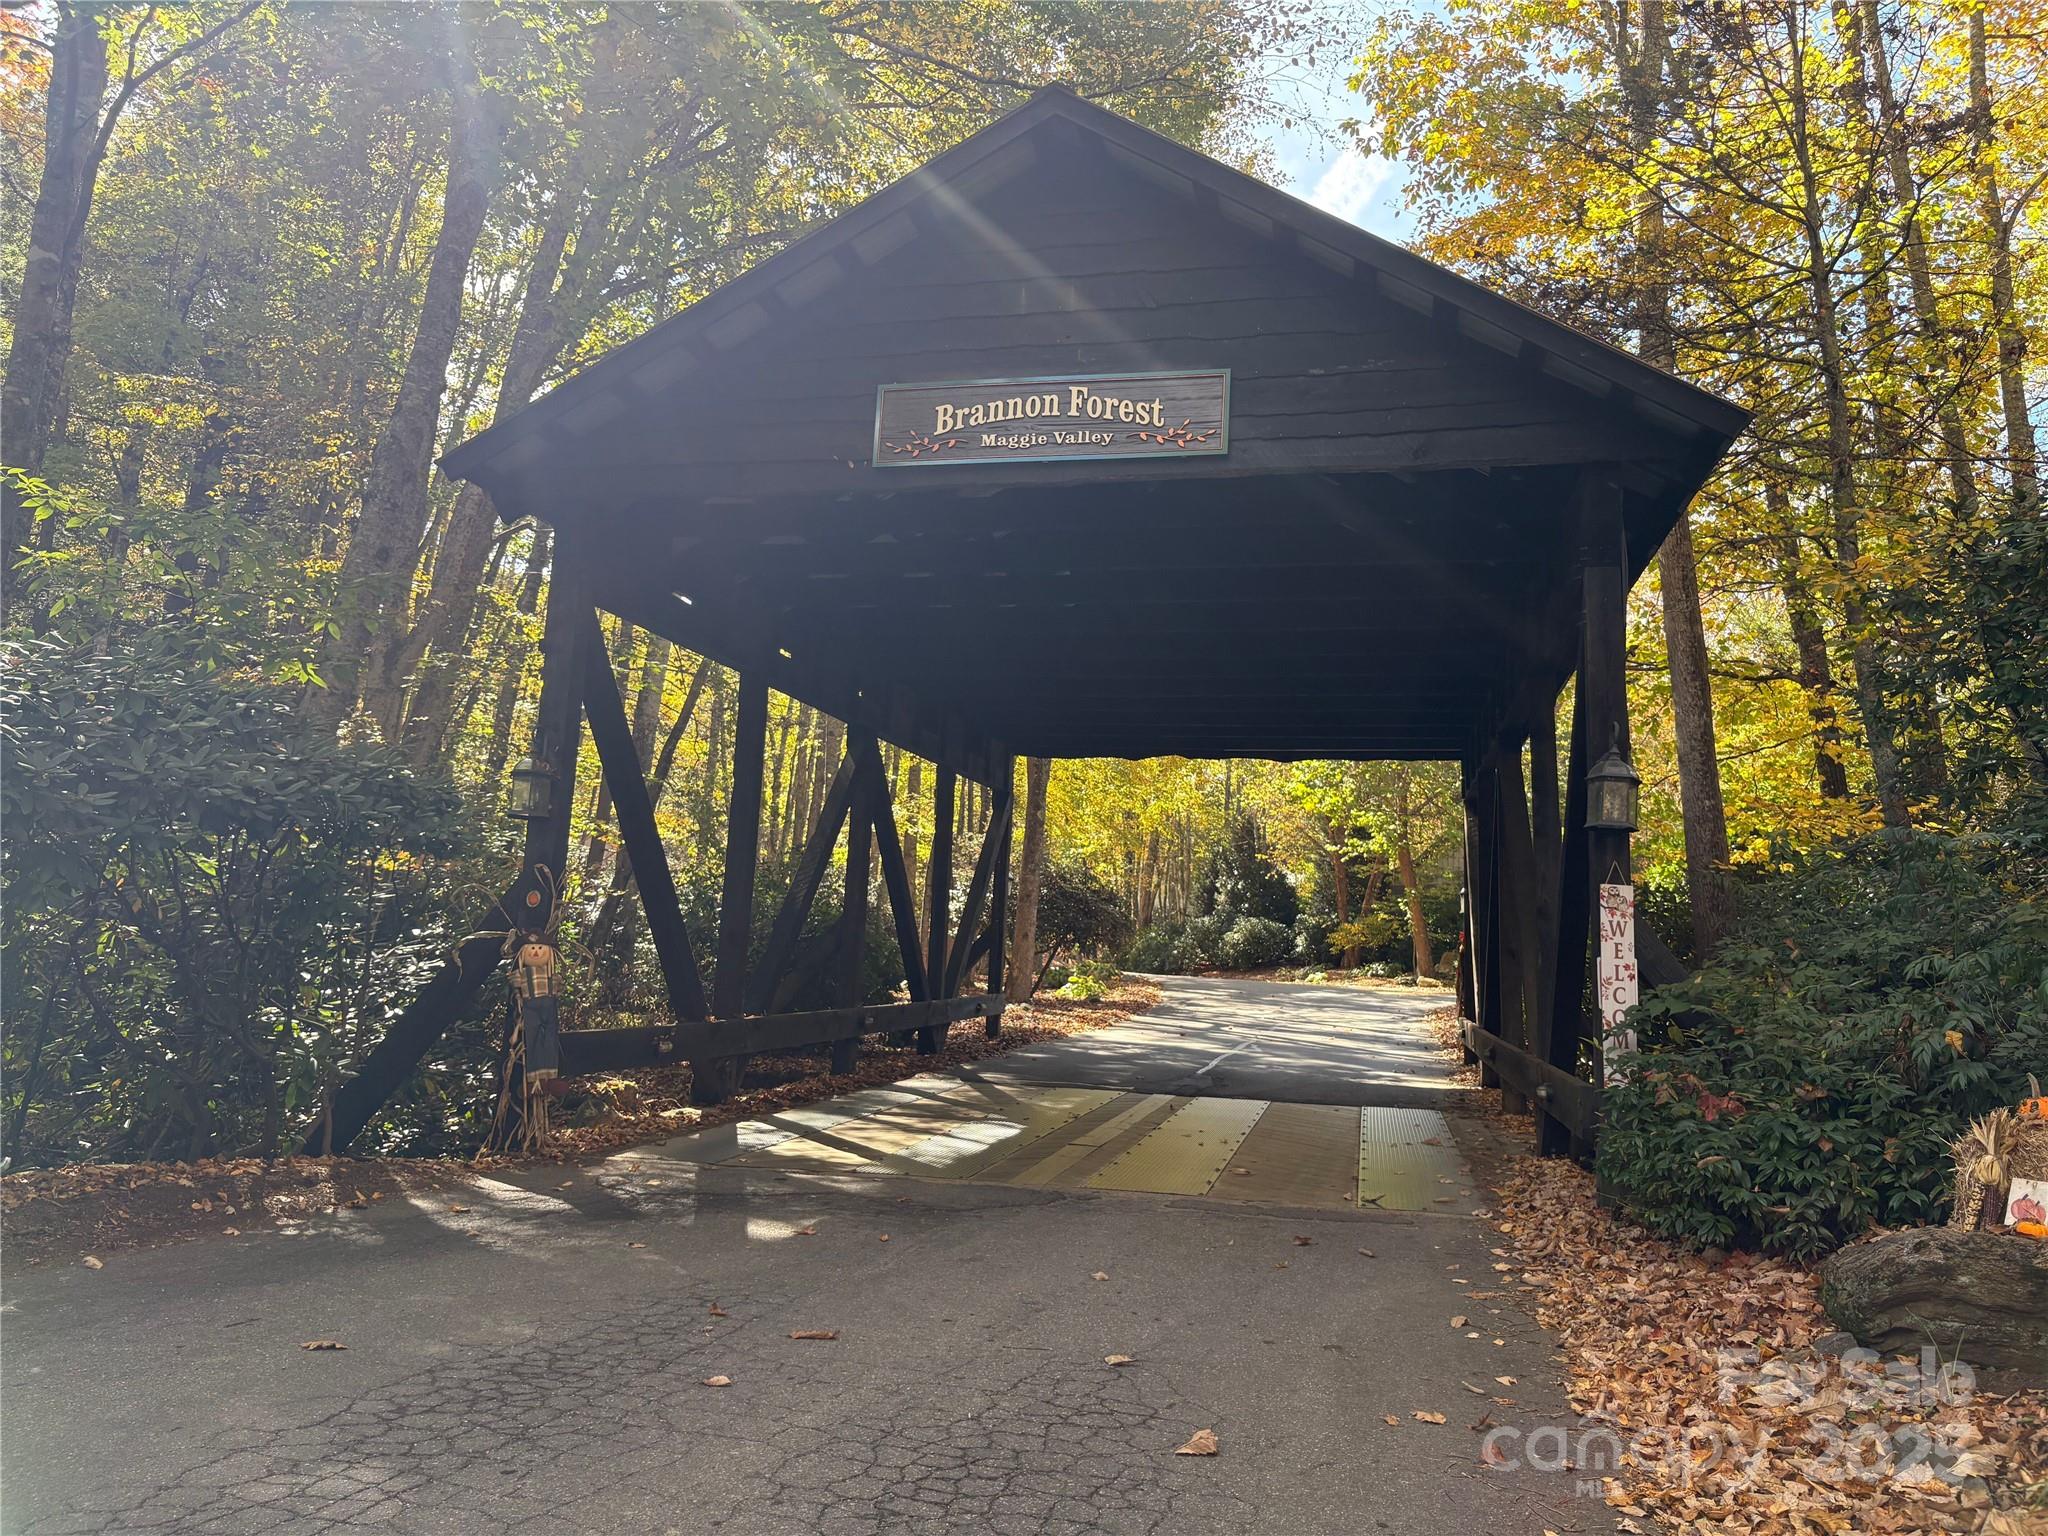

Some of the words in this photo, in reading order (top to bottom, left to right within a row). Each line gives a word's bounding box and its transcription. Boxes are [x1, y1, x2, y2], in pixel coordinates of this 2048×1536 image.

[934, 394, 1061, 436] Brannon
[1067, 385, 1165, 427] Forest
[980, 432, 1048, 450] Maggie
[1053, 431, 1114, 446] Valley
